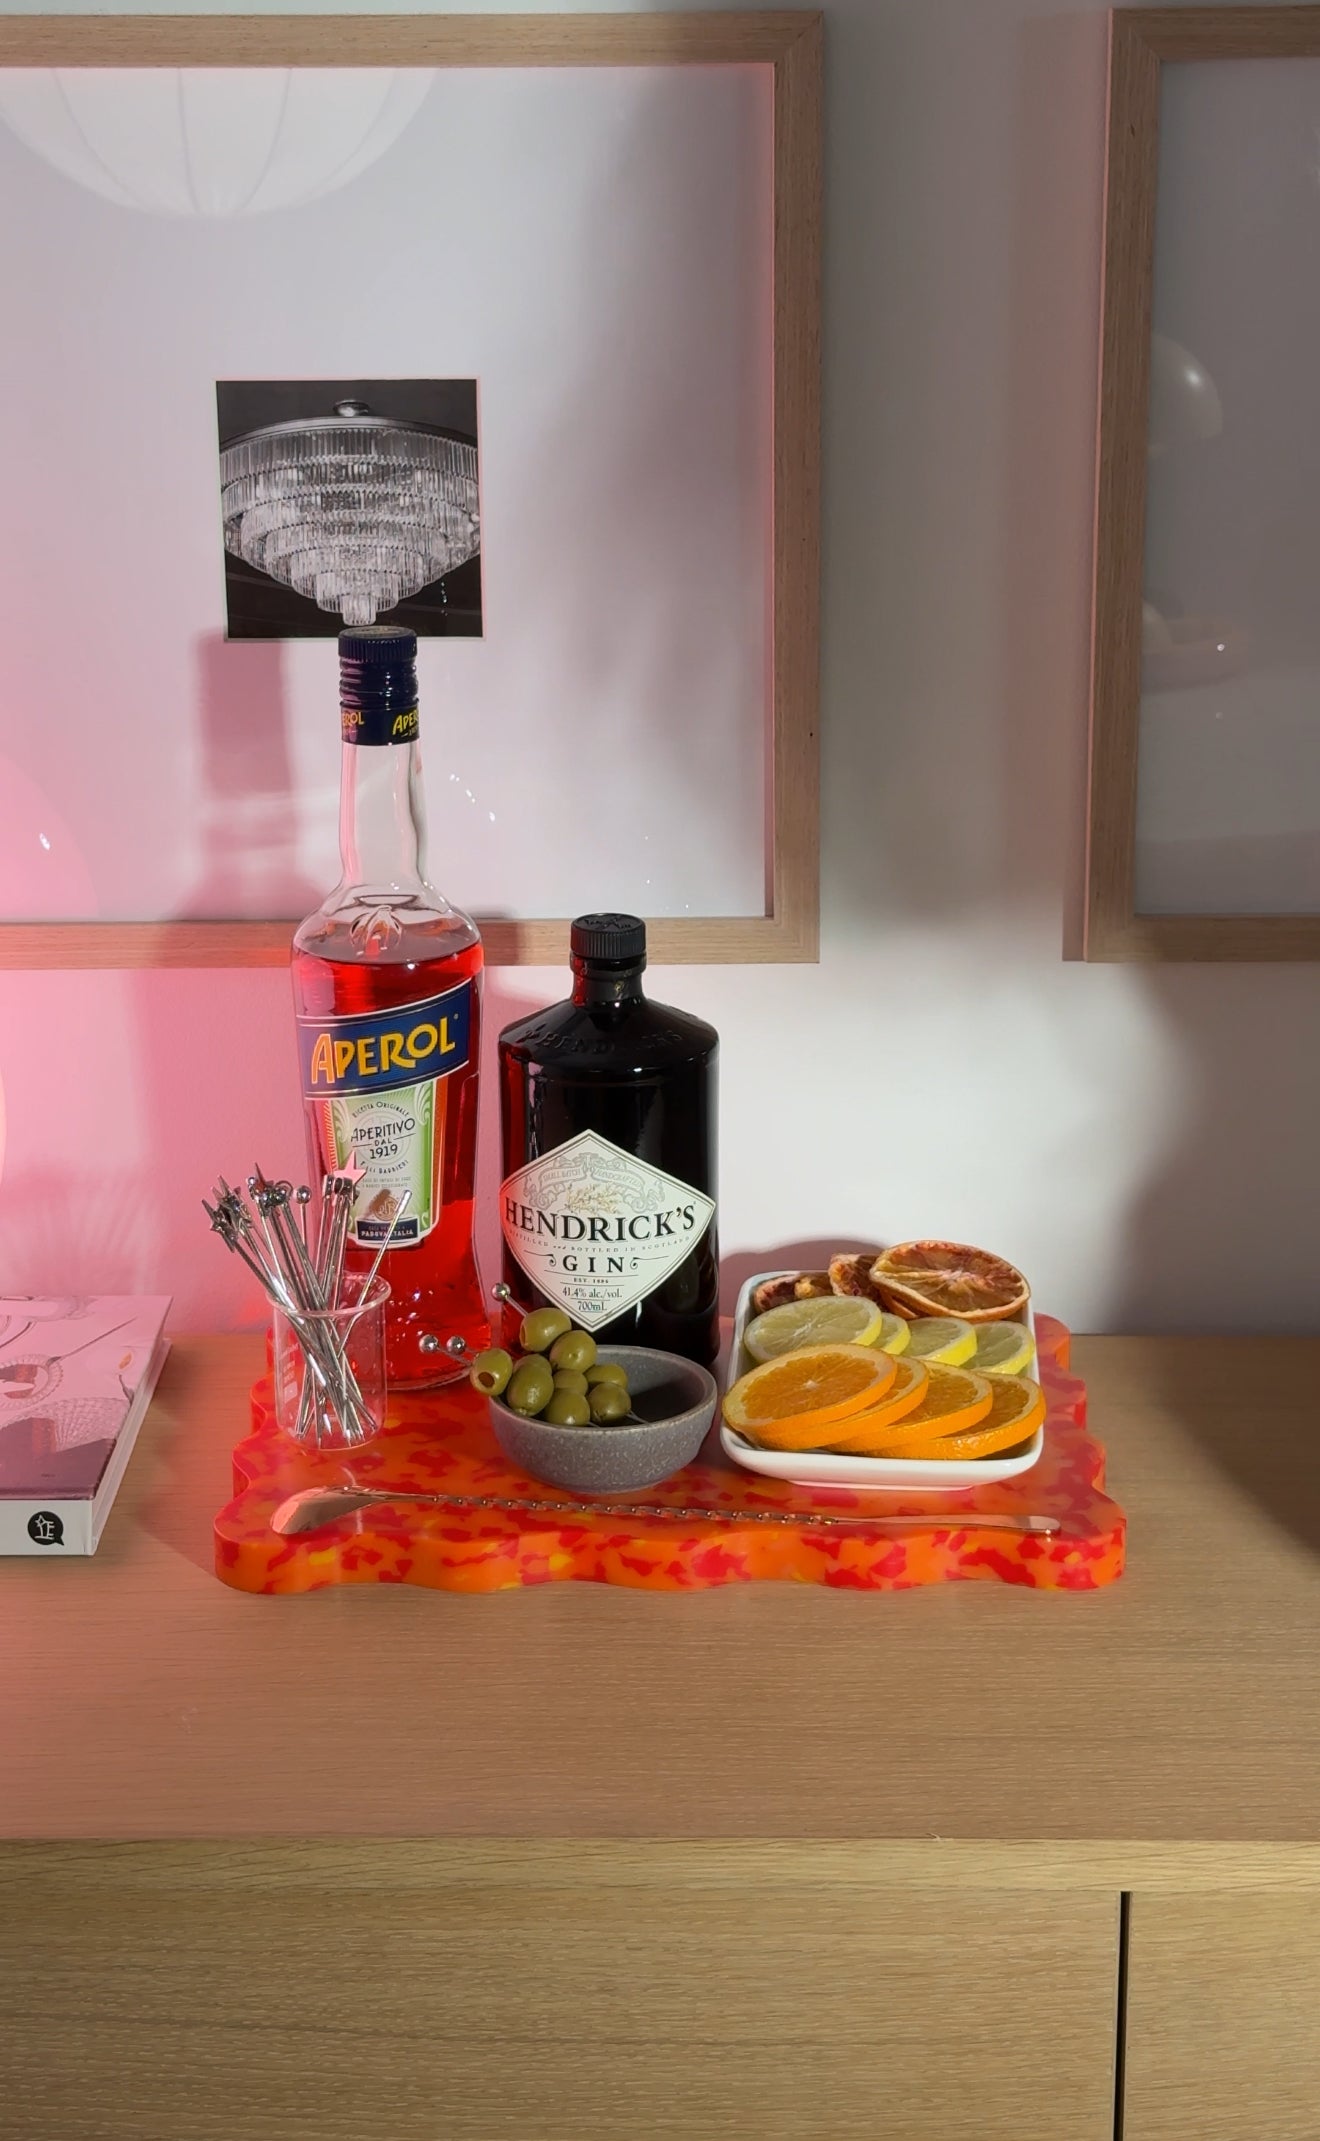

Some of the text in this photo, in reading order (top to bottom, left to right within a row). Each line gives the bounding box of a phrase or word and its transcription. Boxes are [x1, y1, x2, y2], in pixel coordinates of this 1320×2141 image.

[311, 1016, 456, 1085] APEROL
[350, 1118, 416, 1142] APERITIVO
[374, 1138, 392, 1147] DAL
[369, 1144, 398, 1160] 1919
[505, 1197, 695, 1242] HENDRICK'S
[571, 1245, 619, 1253] BOTTLED
[642, 1236, 690, 1251] SCOTLAND
[562, 1255, 624, 1273] GIN
[562, 1285, 623, 1299] 41.4% alc./vol.
[577, 1301, 607, 1311] 700mL
